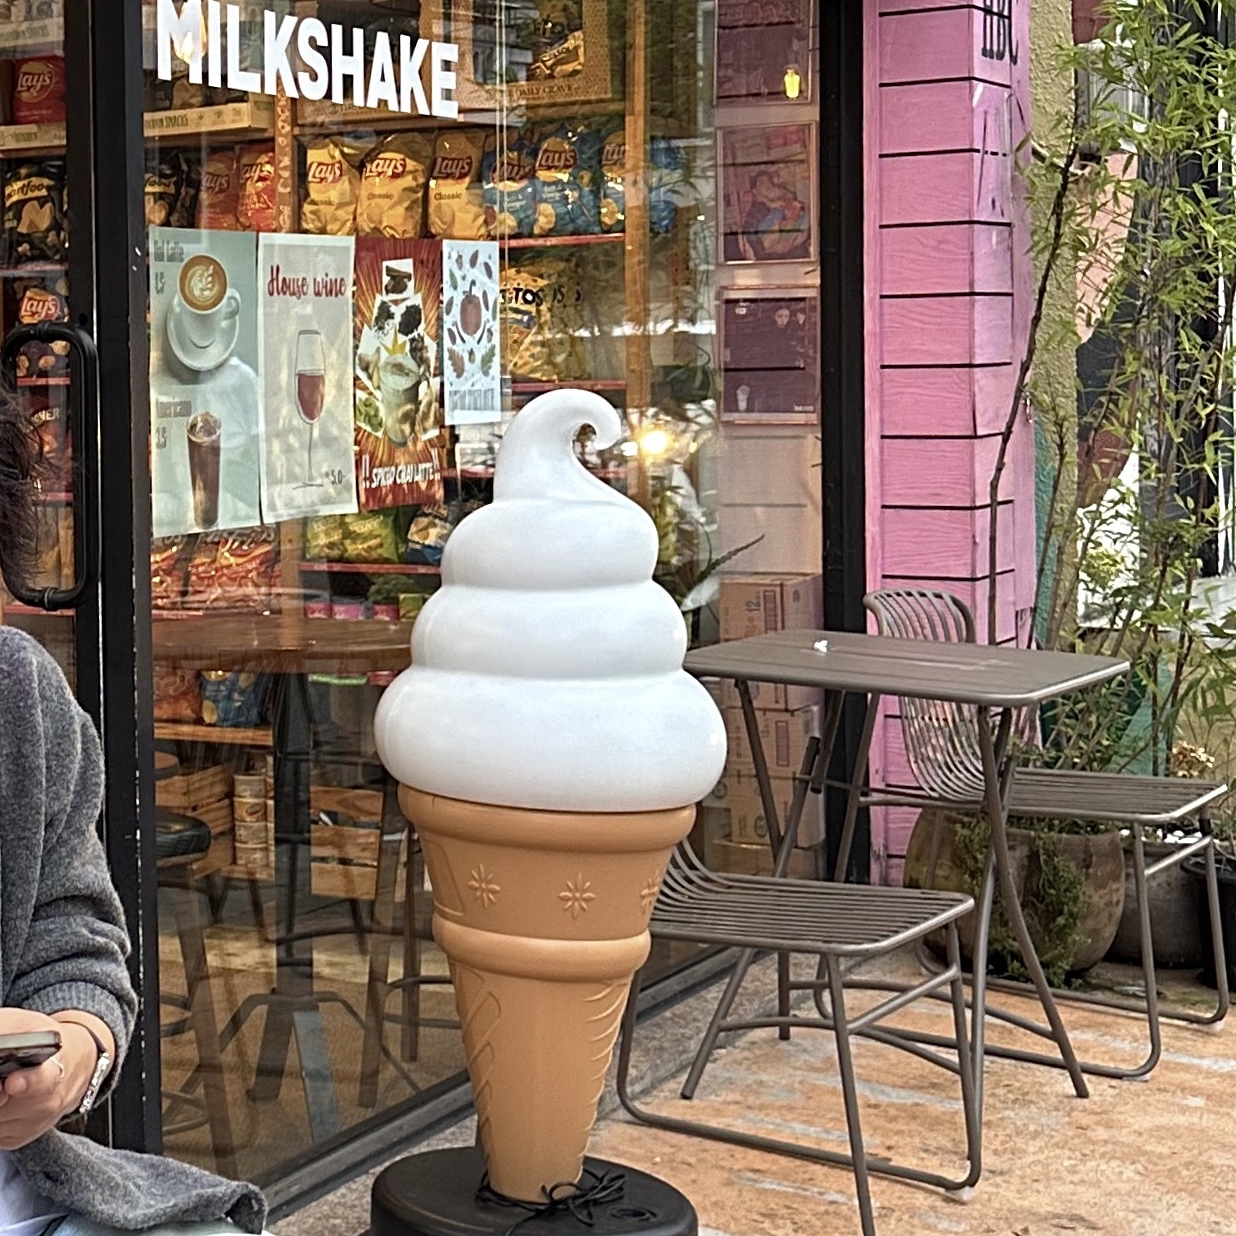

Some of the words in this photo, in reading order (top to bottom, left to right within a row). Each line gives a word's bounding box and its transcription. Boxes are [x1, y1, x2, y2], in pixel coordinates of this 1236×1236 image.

[157, 0, 460, 120] MILKSHAKE
[309, 162, 342, 183] Lay's
[433, 156, 473, 179] Lay's
[434, 192, 463, 201] Classic
[267, 264, 308, 300] House
[313, 271, 347, 298] wine
[22, 296, 58, 321] Lay's
